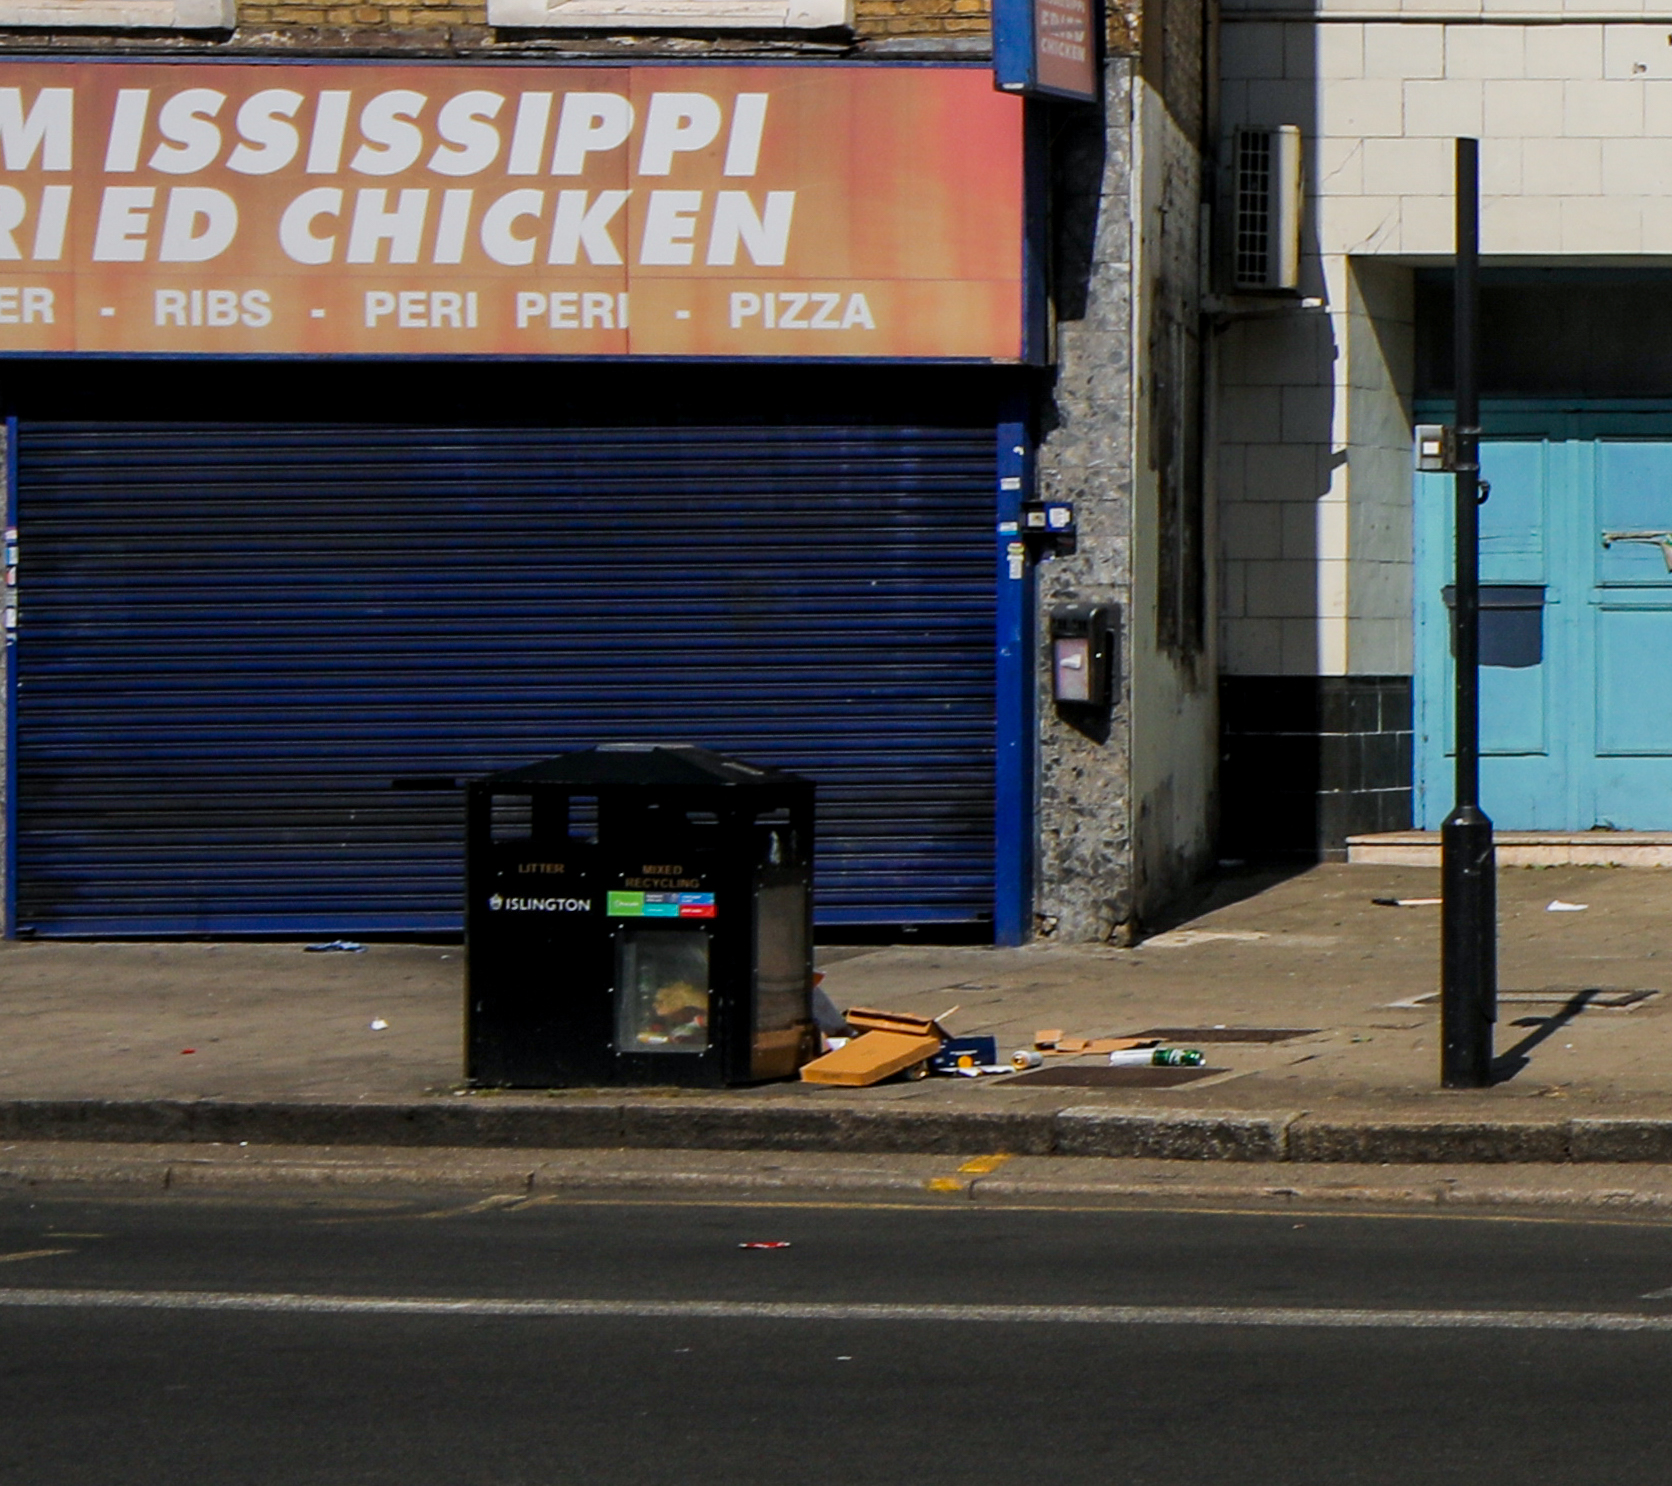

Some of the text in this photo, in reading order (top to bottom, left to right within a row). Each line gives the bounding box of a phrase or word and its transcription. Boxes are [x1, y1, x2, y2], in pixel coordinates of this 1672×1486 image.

[279, 187, 796, 266] CHICKEN
[154, 289, 272, 327] RIBS
[365, 291, 477, 328] PERI
[516, 292, 629, 329] PERI
[729, 292, 876, 330] PIZZA
[518, 863, 566, 874] LITTER
[641, 864, 684, 875] MIXED
[624, 877, 701, 889] RECYCLING
[505, 897, 592, 913] ISLINGTON
